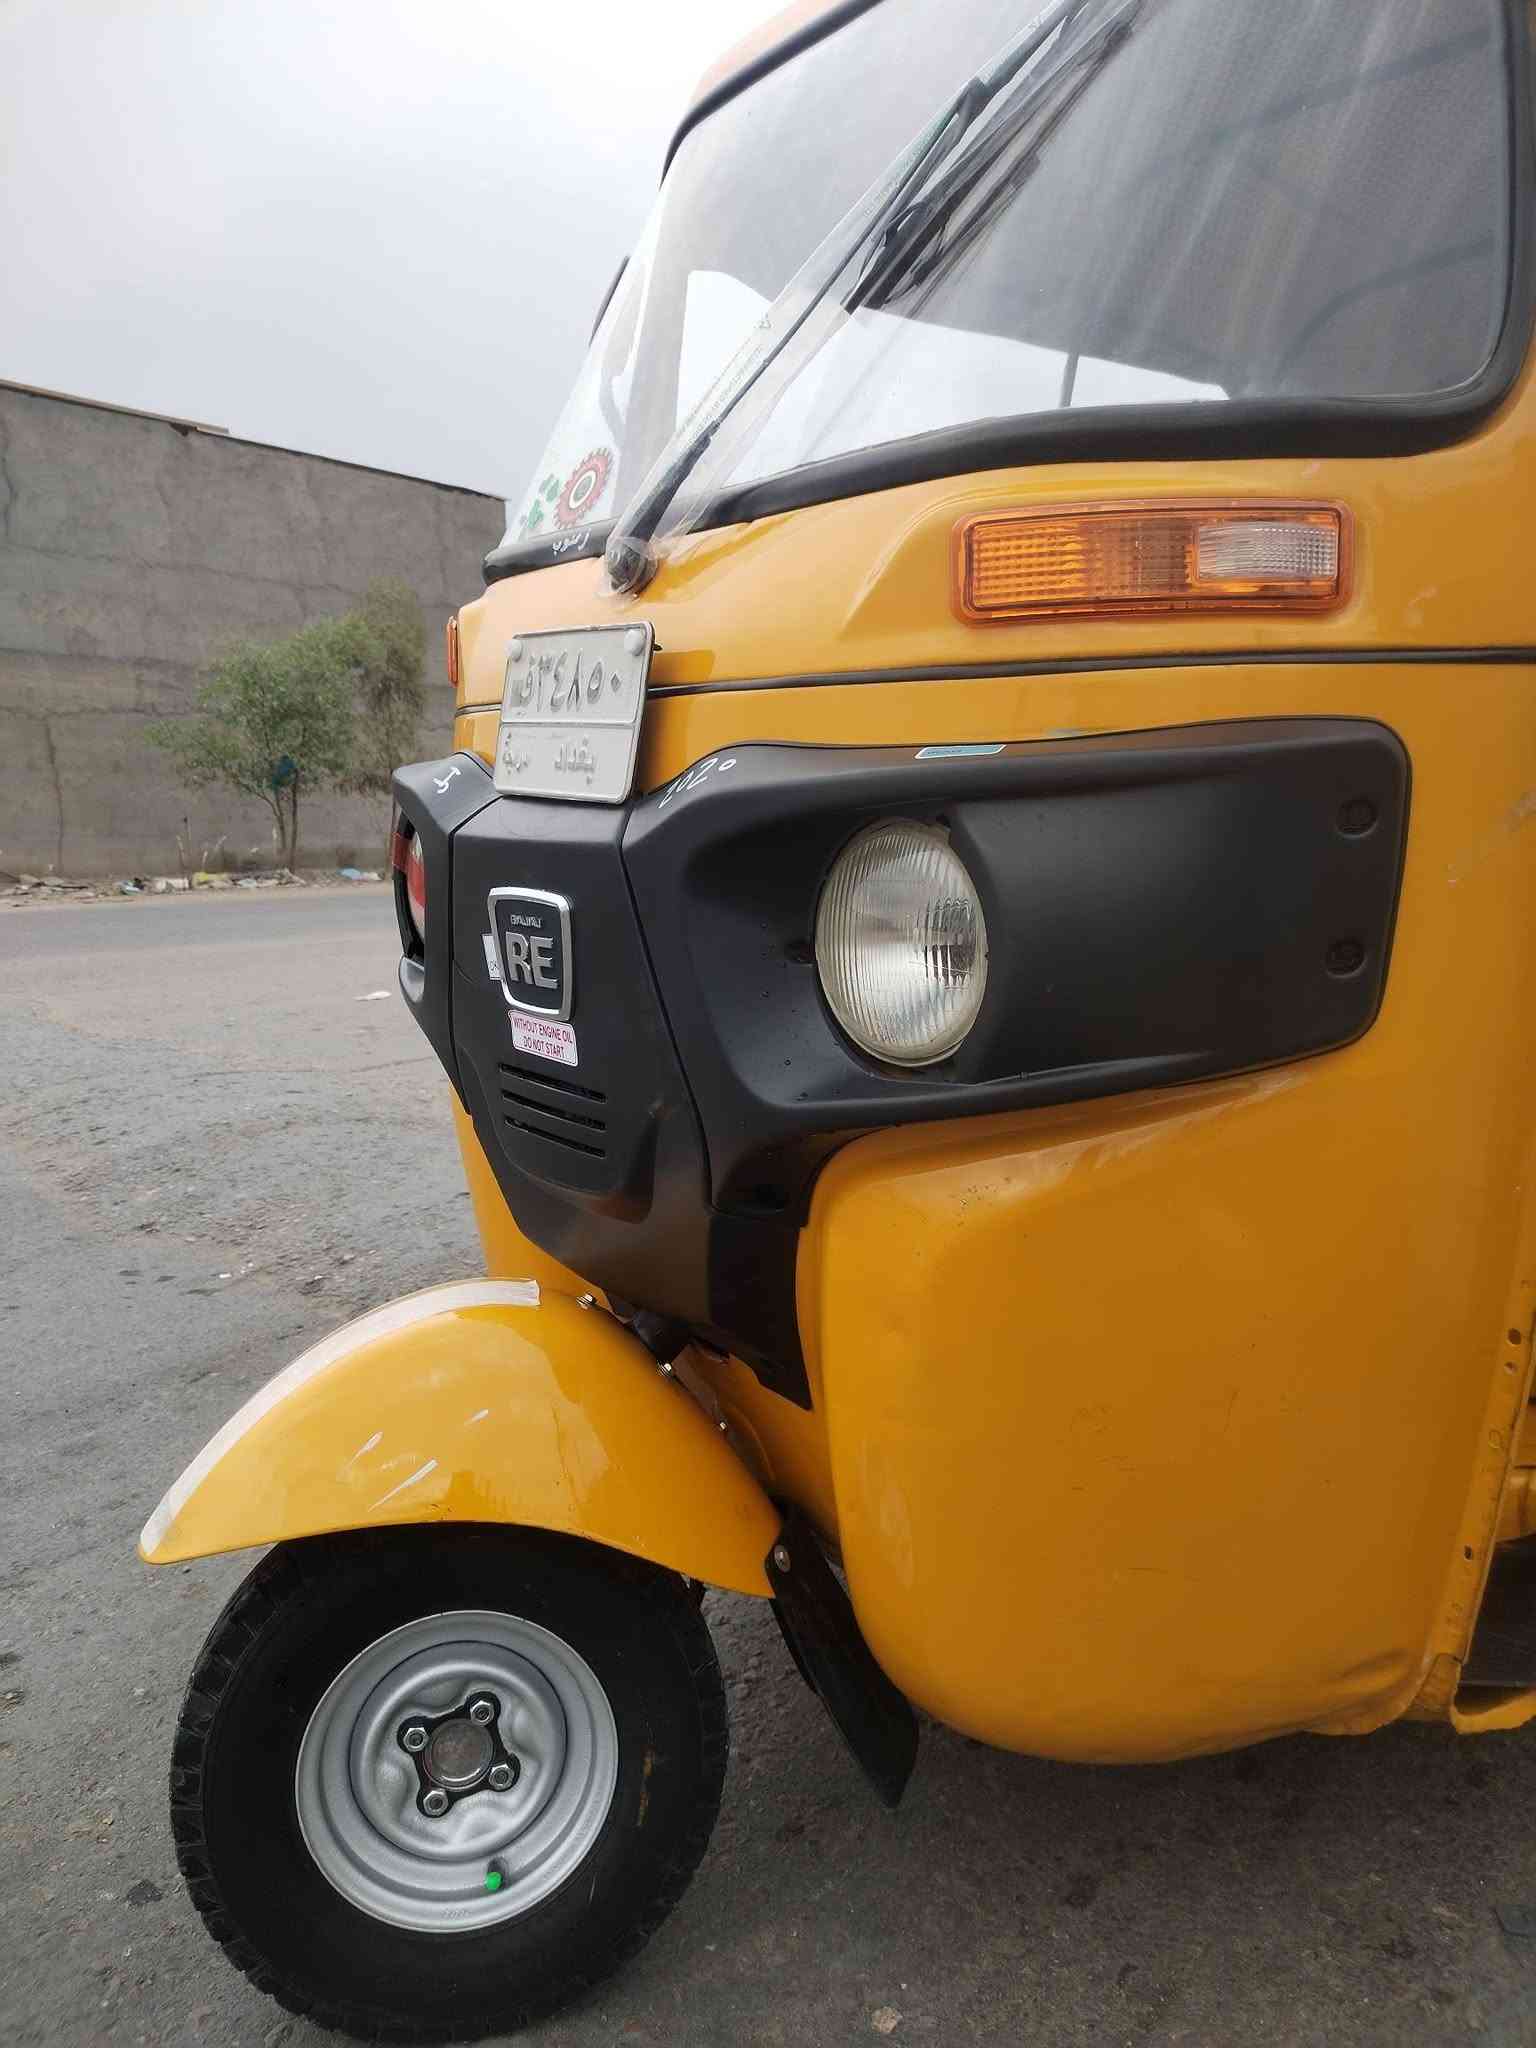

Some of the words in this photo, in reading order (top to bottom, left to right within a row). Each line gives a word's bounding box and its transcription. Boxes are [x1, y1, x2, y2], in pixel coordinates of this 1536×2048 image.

[505, 931, 559, 989] RE
[513, 1016, 538, 1034] WITHOUT
[539, 1023, 561, 1041] ENGINE
[562, 1030, 573, 1044] OIL
[523, 1036, 532, 1048] DO
[533, 1039, 545, 1051] NOT
[545, 1042, 565, 1059] START
